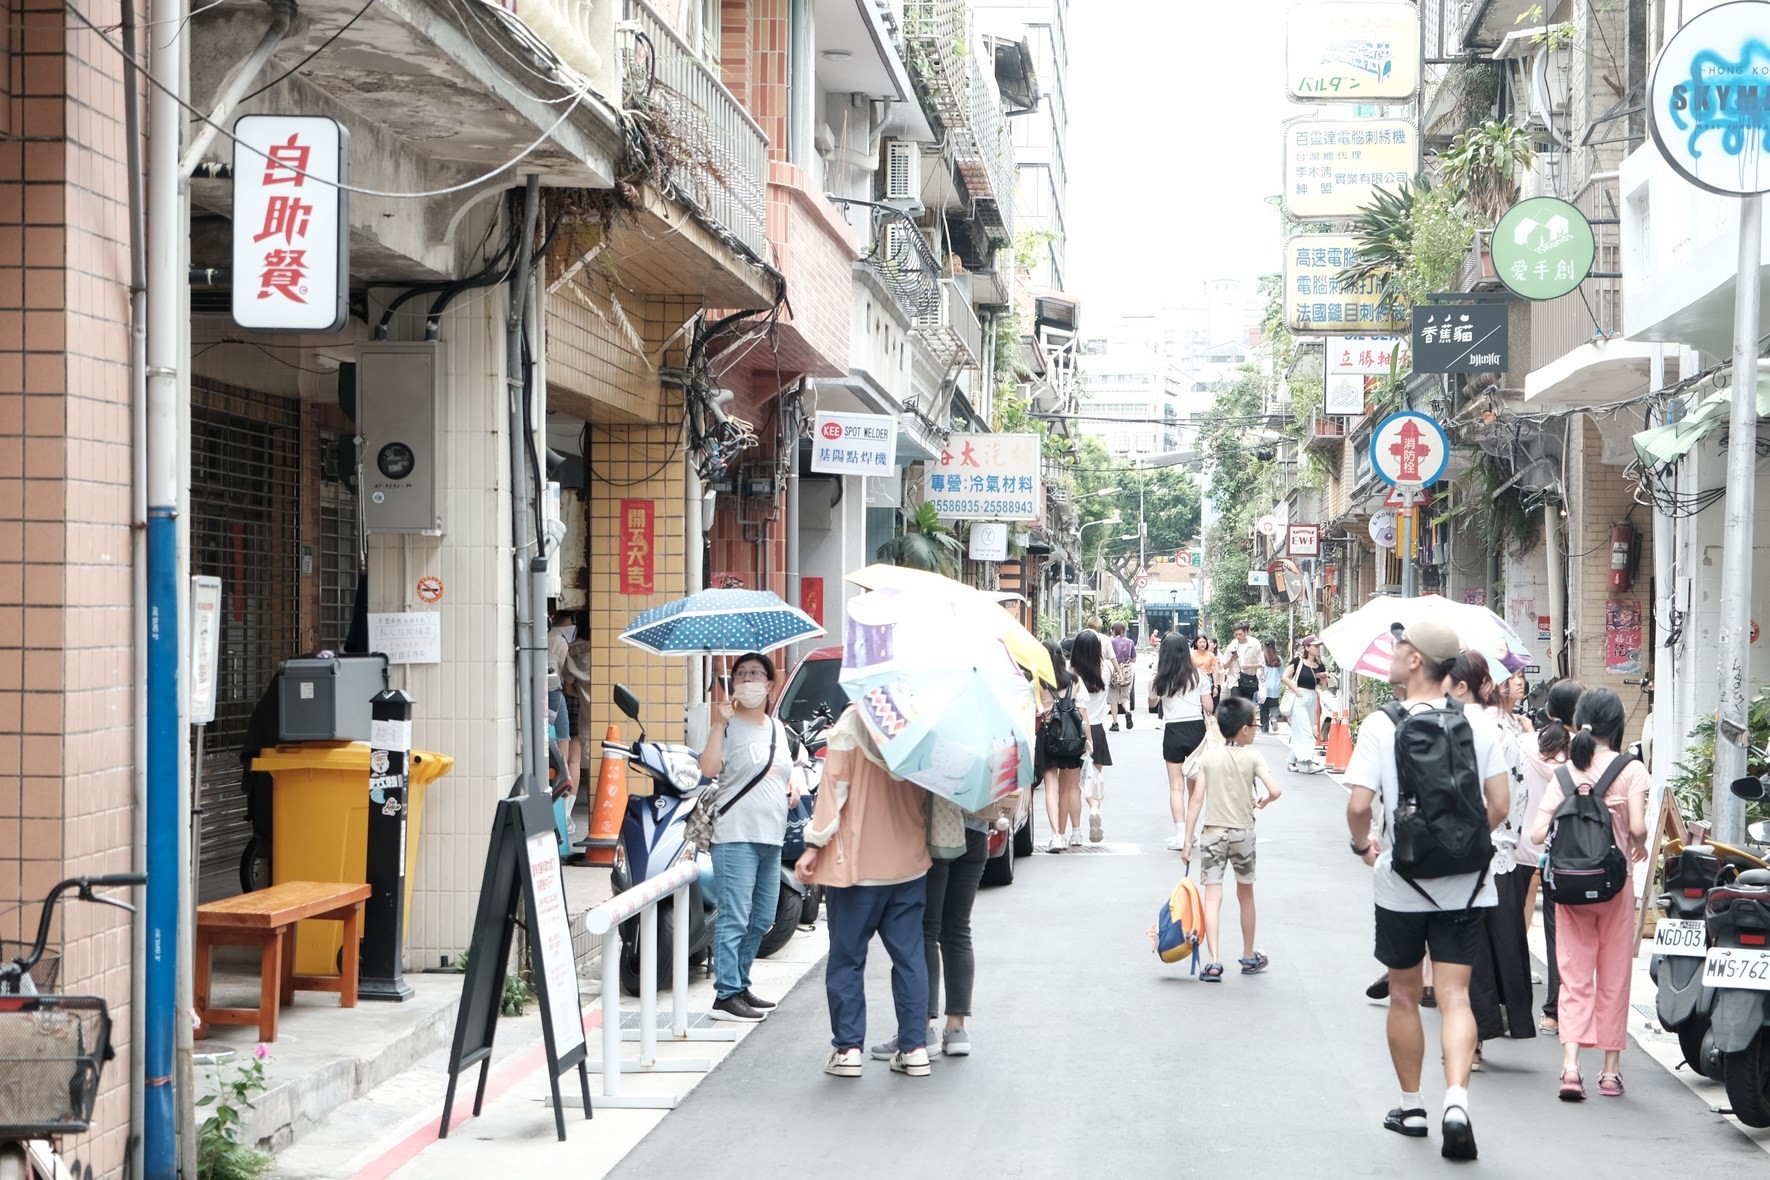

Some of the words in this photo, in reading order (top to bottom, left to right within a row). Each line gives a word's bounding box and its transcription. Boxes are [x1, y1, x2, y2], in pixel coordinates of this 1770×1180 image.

[1708, 66, 1743, 75] HONG
[1298, 76, 1361, 92] バルダン
[253, 132, 313, 305] 自助餐
[1510, 259, 1575, 281] 愛手創
[1421, 323, 1474, 344] 香蕉貓
[823, 427, 841, 438] KEE
[844, 427, 861, 438] SPOT
[863, 428, 889, 439] WELDER
[1403, 437, 1416, 474] 消防栓
[627, 508, 646, 585] 開工大吉
